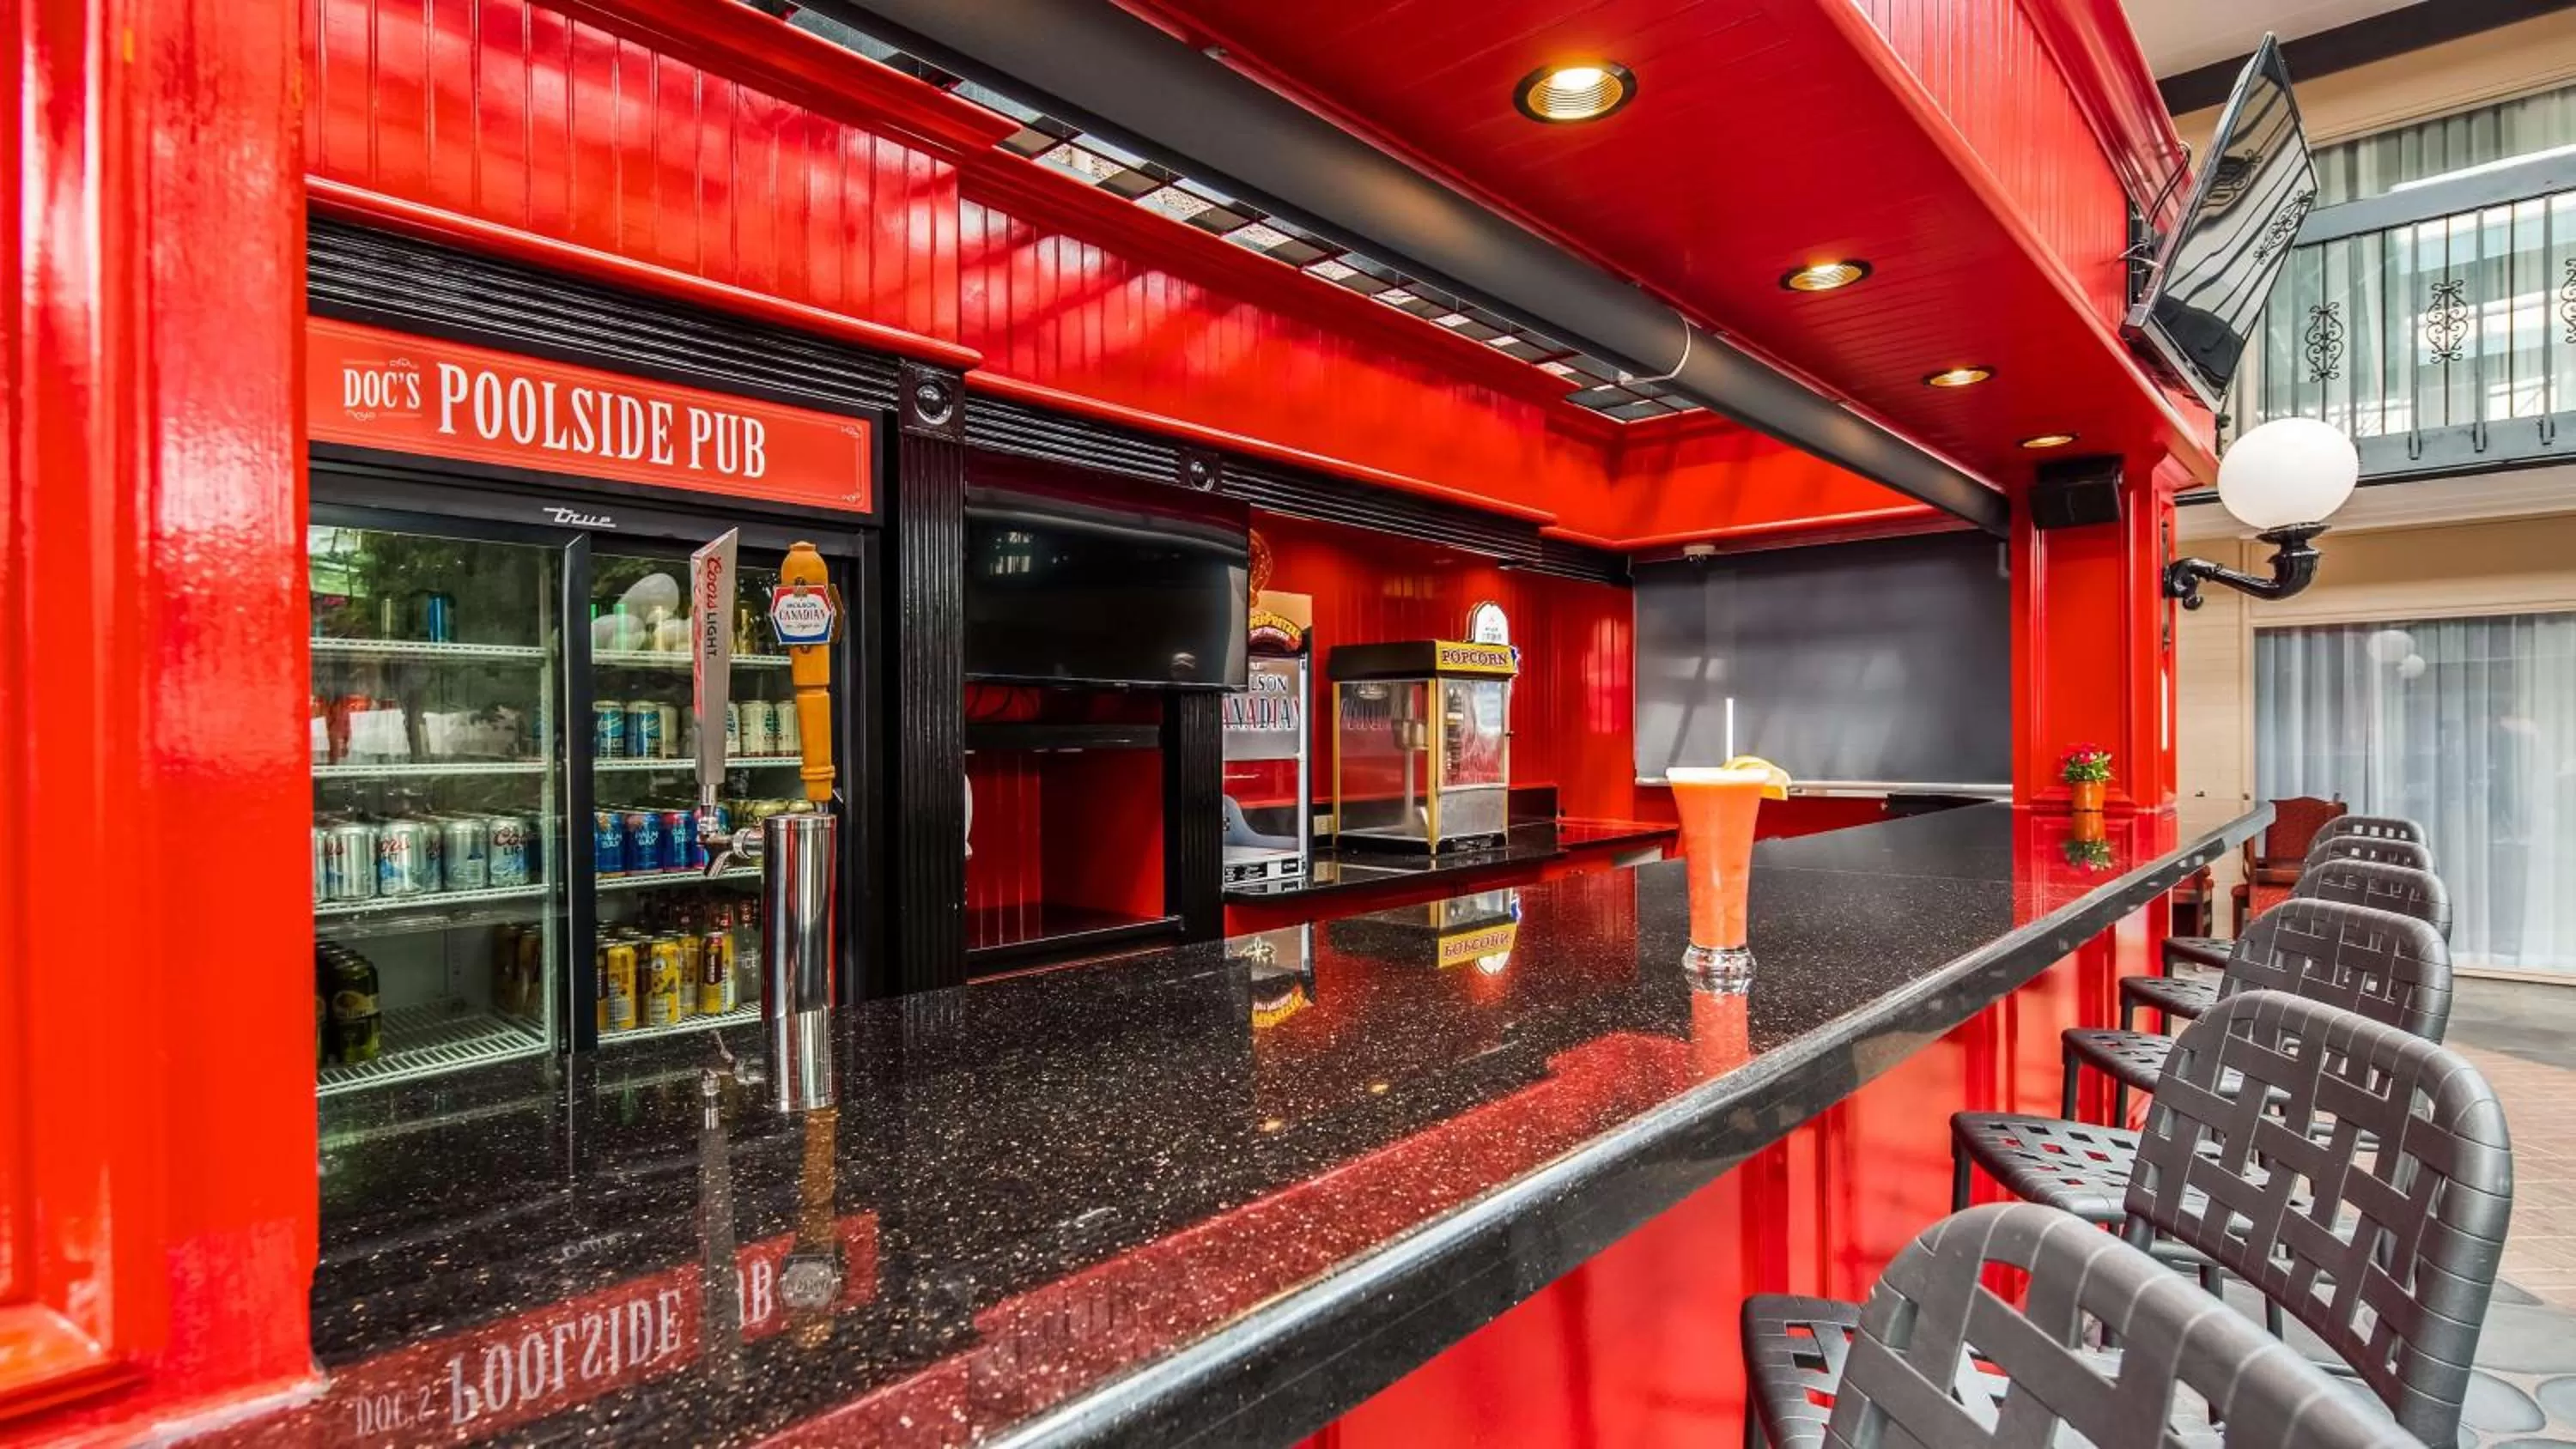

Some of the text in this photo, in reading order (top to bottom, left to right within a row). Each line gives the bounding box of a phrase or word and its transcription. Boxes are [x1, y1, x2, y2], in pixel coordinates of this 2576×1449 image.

[343, 361, 767, 479] DOC'S POOLSIDE PUB
[543, 508, 617, 528] True
[706, 556, 722, 659] Coors LIGHT
[1441, 650, 1509, 666] POPCORN
